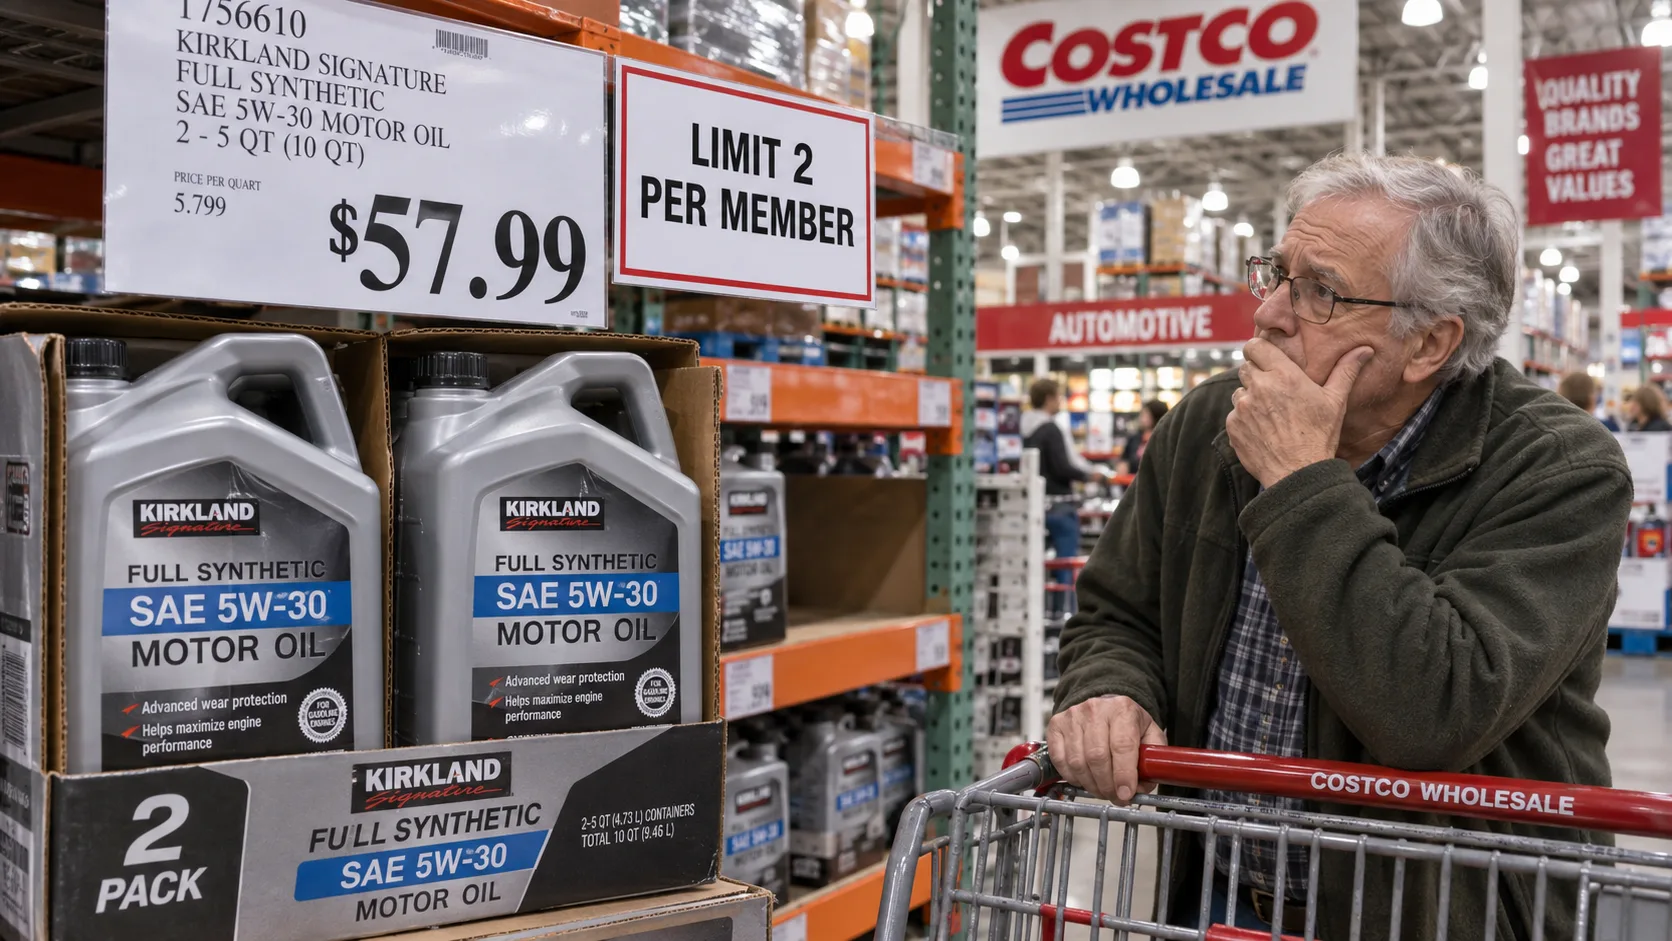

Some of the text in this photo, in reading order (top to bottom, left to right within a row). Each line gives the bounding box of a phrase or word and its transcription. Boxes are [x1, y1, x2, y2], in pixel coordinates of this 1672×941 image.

[180, 0, 306, 38] 1756610
[176, 29, 447, 95] KIRKLAND SIGNATURE
[1001, 1, 1318, 88] COSTCO
[176, 60, 384, 112] FULL SYNTHETIC
[1086, 65, 1306, 113] WHOLESALE
[1543, 69, 1641, 107] QUALITY
[176, 91, 450, 149] SAE 5W-30 MOTOR OIL
[1544, 102, 1640, 138] BRANDS
[176, 121, 190, 144] 2
[218, 126, 229, 148] 5
[240, 130, 275, 155] QT
[284, 133, 316, 161] (10
[324, 140, 365, 169] QT)
[692, 123, 813, 185] LIMIT 2
[1546, 138, 1622, 172] GREAT
[174, 171, 261, 192] PRICE PER QUART
[1545, 169, 1635, 203] VALUES
[174, 192, 226, 217] 5.799
[641, 175, 854, 247] PER MEMBER
[329, 194, 586, 304] $57.99
[1049, 306, 1212, 344] AUTOMOTIVE
[140, 502, 254, 522] KIRKLAND
[506, 500, 600, 517] KIRKLAND
[506, 517, 601, 530] Signature
[141, 522, 254, 537] Signature
[128, 560, 325, 584] FULL SYNTHETIC
[495, 553, 657, 572] FULL SYNTHETIC
[130, 589, 327, 628] SAE 5W-30
[496, 580, 658, 610] SAE 5W-30
[132, 631, 325, 668] MOTOR OIL
[498, 618, 656, 646] MOTOR OIL
[505, 671, 625, 686] Advanced wear protection
[142, 692, 288, 715] Advanced wear protection
[505, 691, 603, 709] Helps maximize engine
[505, 709, 561, 724] performance
[142, 715, 262, 740] Helps maximize engine
[142, 738, 212, 757] performance
[365, 758, 501, 793] KIRKLAND
[365, 783, 502, 810] Signature
[1311, 772, 1575, 816] COSTCO WHOLESALE
[123, 793, 190, 866] 2
[309, 802, 541, 854] FULL SYNTHETIC
[581, 803, 695, 830] 2-5 QT (4.73 L) CONTAINERS
[581, 822, 675, 848] TOTAL 10 QT (9.46 L)
[340, 842, 508, 889] SAE 5W-30
[95, 866, 208, 914] PACK
[355, 881, 501, 923] MOTOR OIL
